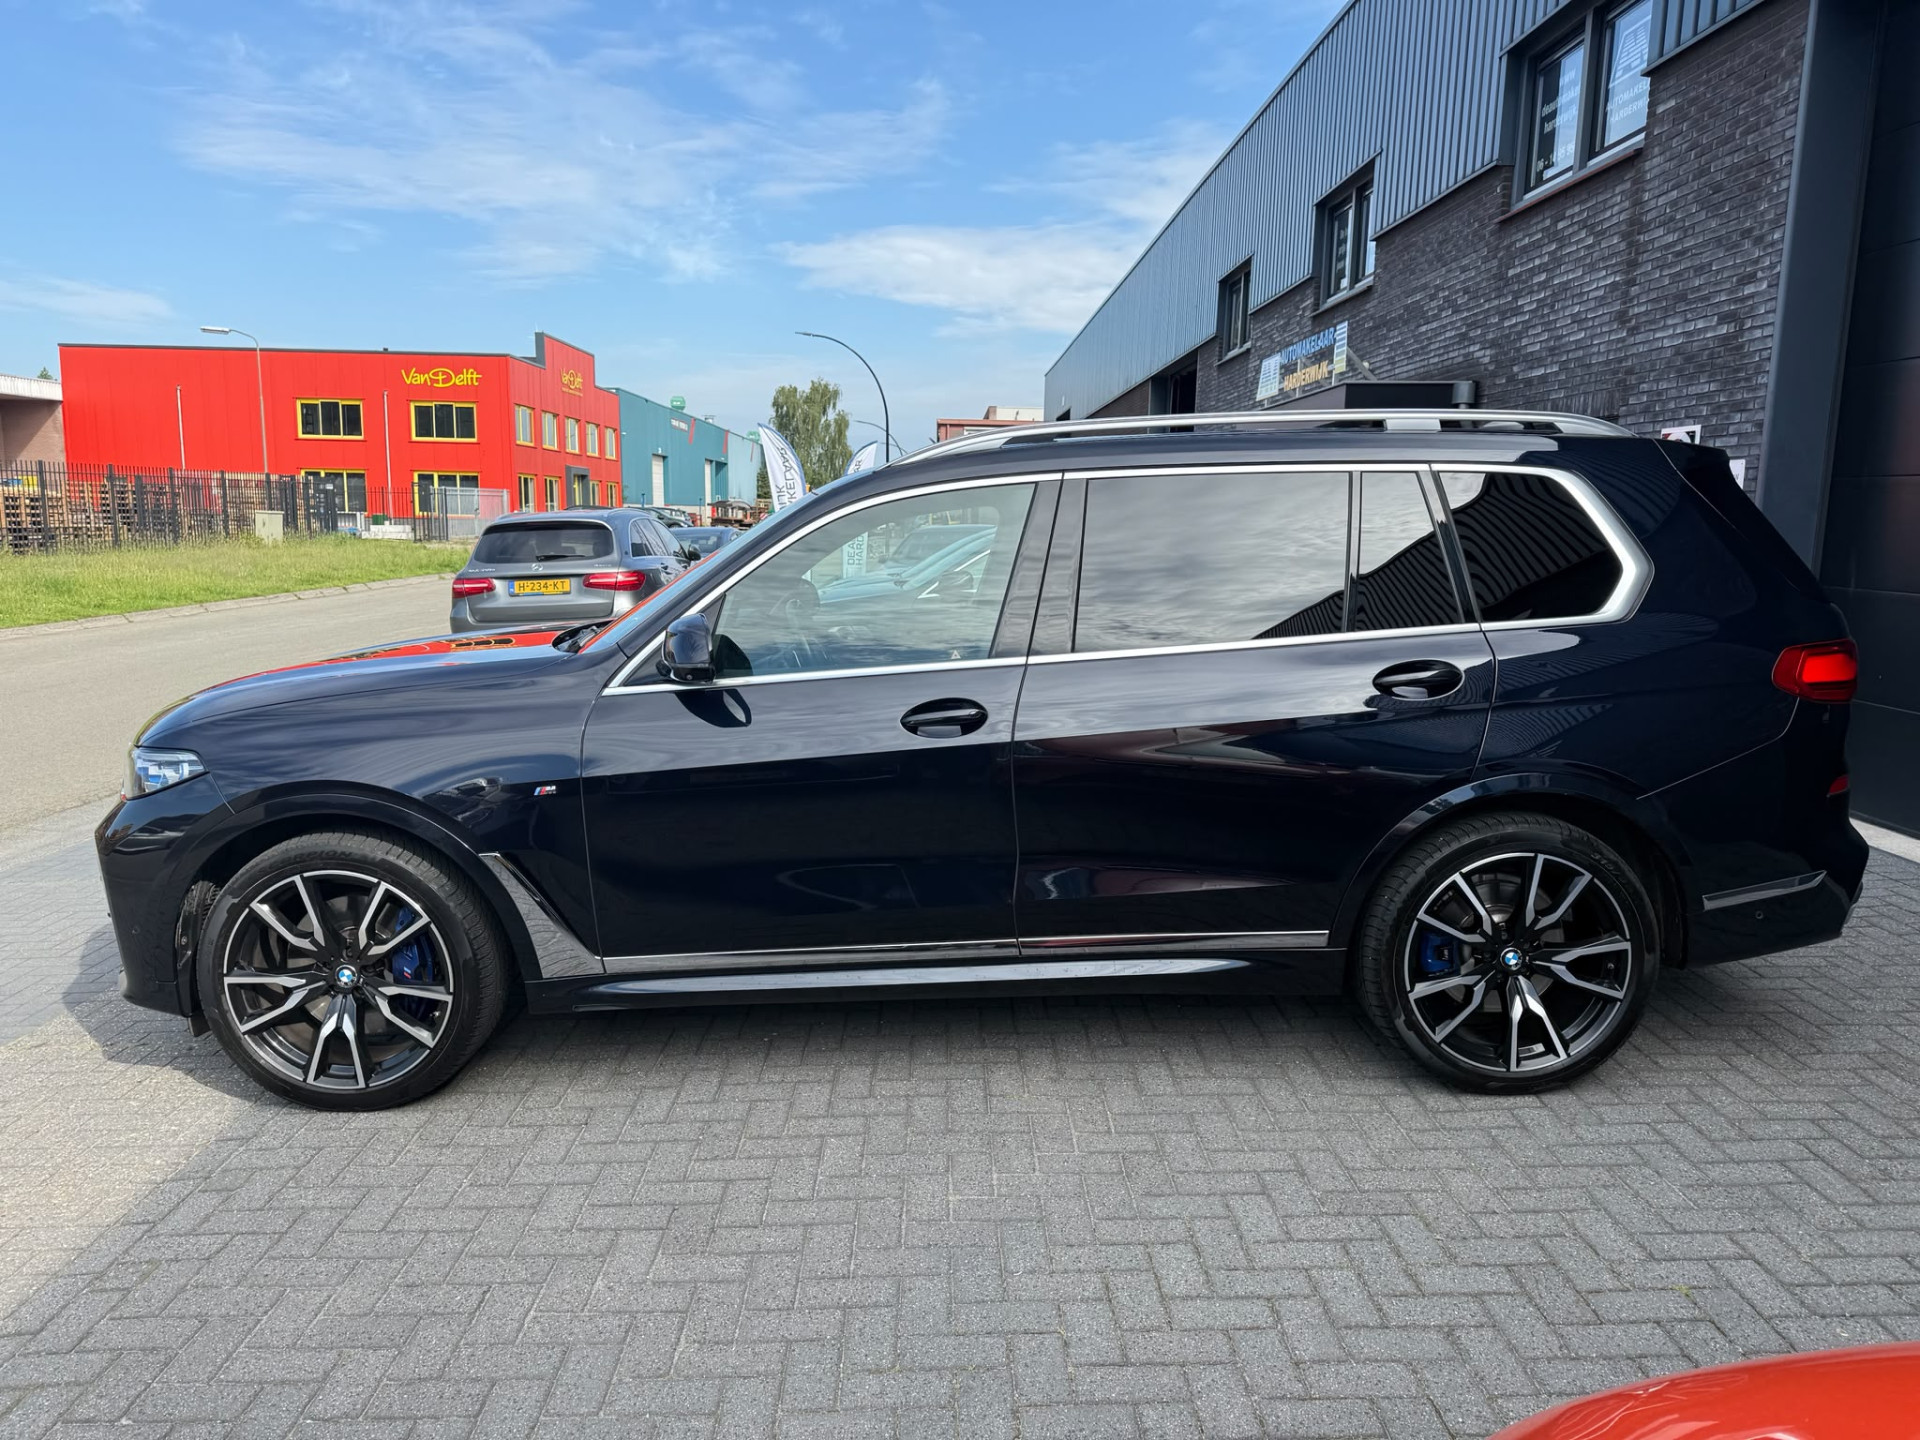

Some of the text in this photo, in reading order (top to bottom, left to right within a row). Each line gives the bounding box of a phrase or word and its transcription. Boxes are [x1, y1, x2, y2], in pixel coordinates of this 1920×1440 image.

[1280, 327, 1335, 367] AUTOMAKELAAR
[1283, 360, 1329, 392] HARDERWIJK
[518, 580, 566, 592] H-234-KT
